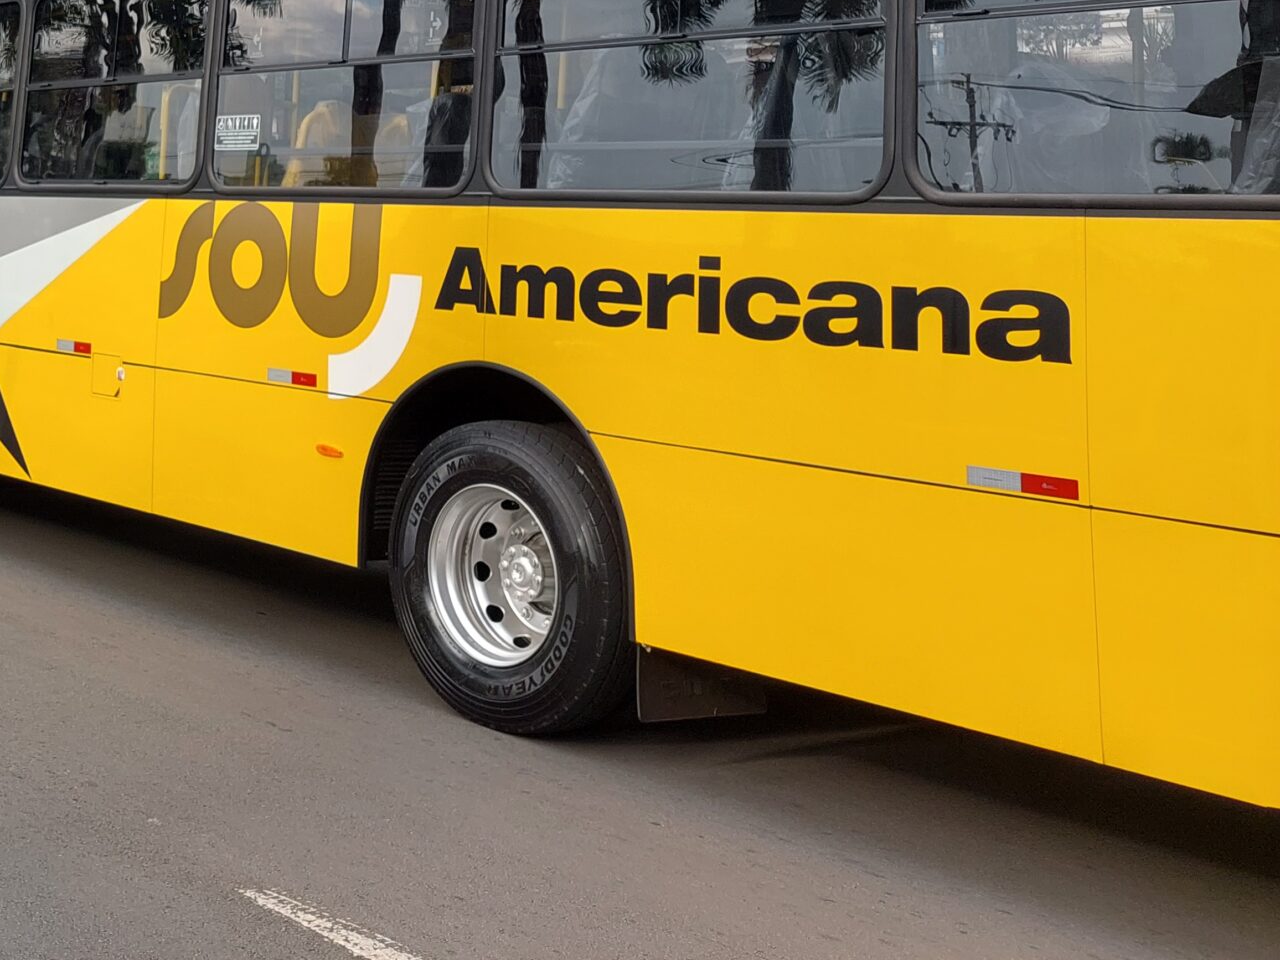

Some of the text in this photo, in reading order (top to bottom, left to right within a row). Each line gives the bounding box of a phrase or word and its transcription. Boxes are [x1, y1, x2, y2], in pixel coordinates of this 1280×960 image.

[434, 246, 1073, 365] Americana
[408, 454, 477, 528] URBAN MAX
[486, 613, 574, 698] GOODYEAR
